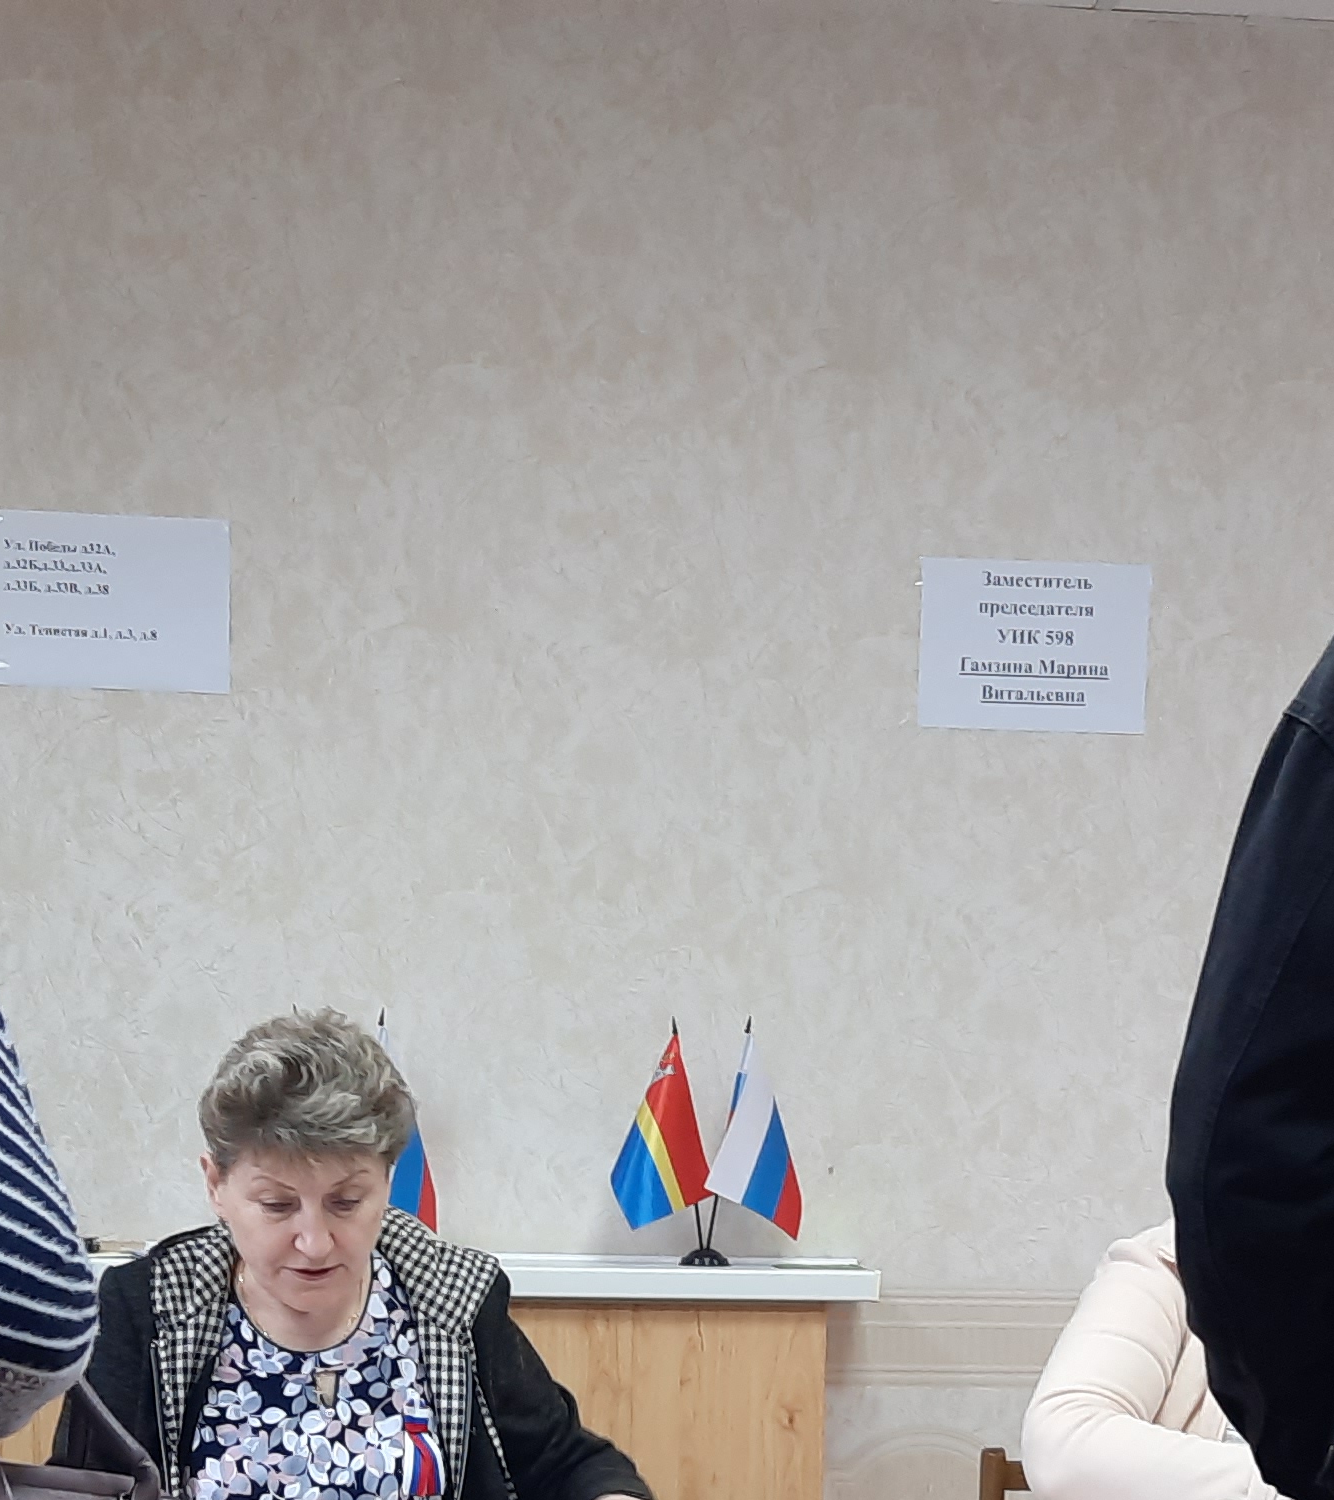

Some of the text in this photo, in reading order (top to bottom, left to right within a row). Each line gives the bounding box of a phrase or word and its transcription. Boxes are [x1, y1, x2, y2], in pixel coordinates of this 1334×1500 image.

[983, 570, 1094, 590] Заместитель
[979, 601, 1095, 618] председателя
[997, 628, 1075, 646] УИК 598
[960, 656, 1109, 679] Гамзина Марина
[981, 684, 1085, 704] Витальевна
